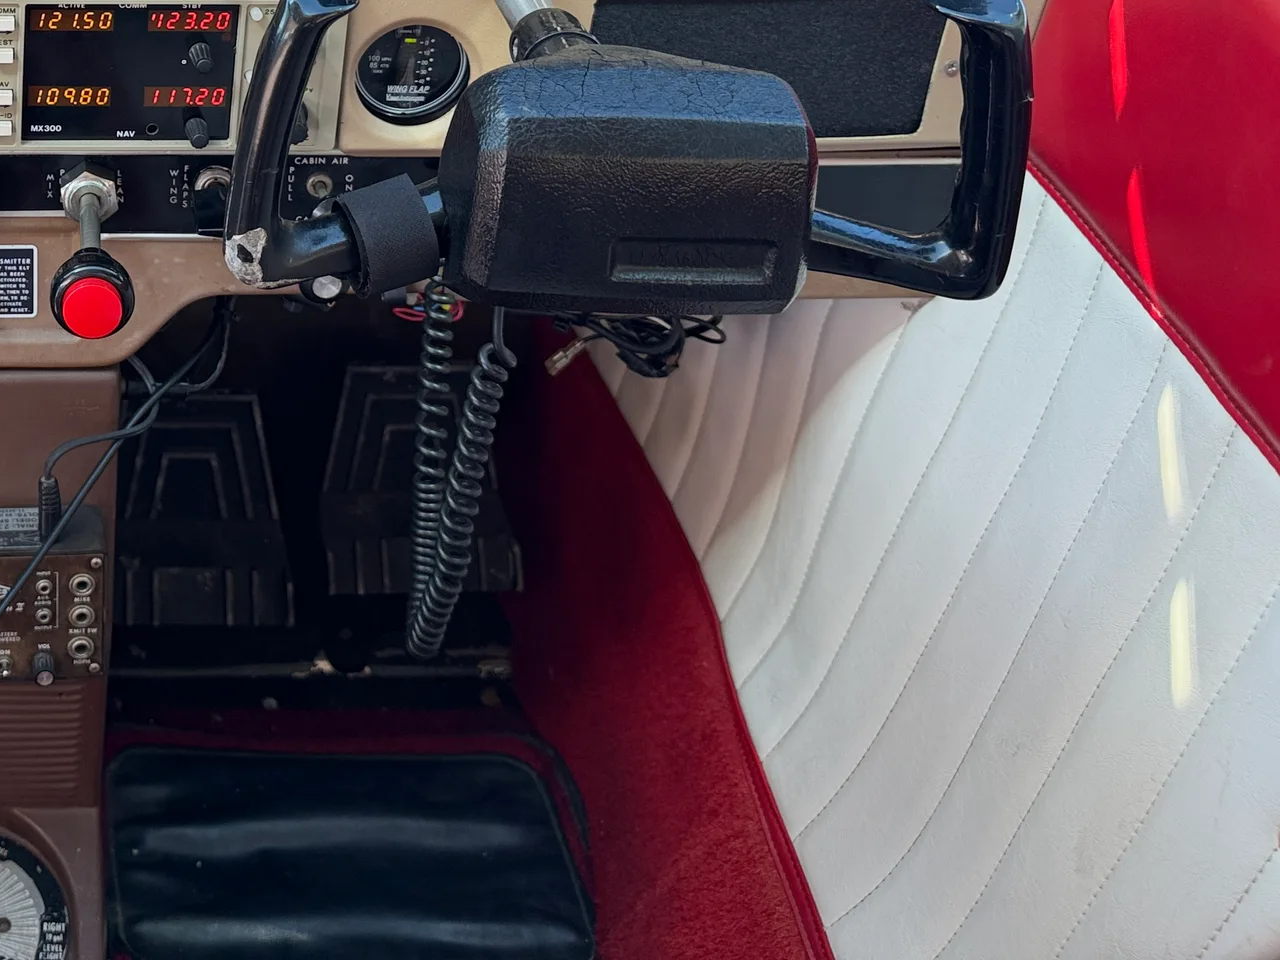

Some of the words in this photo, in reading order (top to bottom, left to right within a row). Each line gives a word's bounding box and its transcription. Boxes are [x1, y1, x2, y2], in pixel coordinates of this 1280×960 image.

[38, 12, 113, 30] 121.50
[37, 88, 110, 105] 109.80
[152, 88, 225, 106] 117.20
[387, 85, 408, 94] WING
[409, 86, 431, 94] FLAP
[294, 157, 326, 165] CABIN
[332, 157, 349, 165] AIR
[46, 174, 55, 199] MIX
[170, 169, 180, 204] WING
[43, 922, 66, 933] RIGHT
